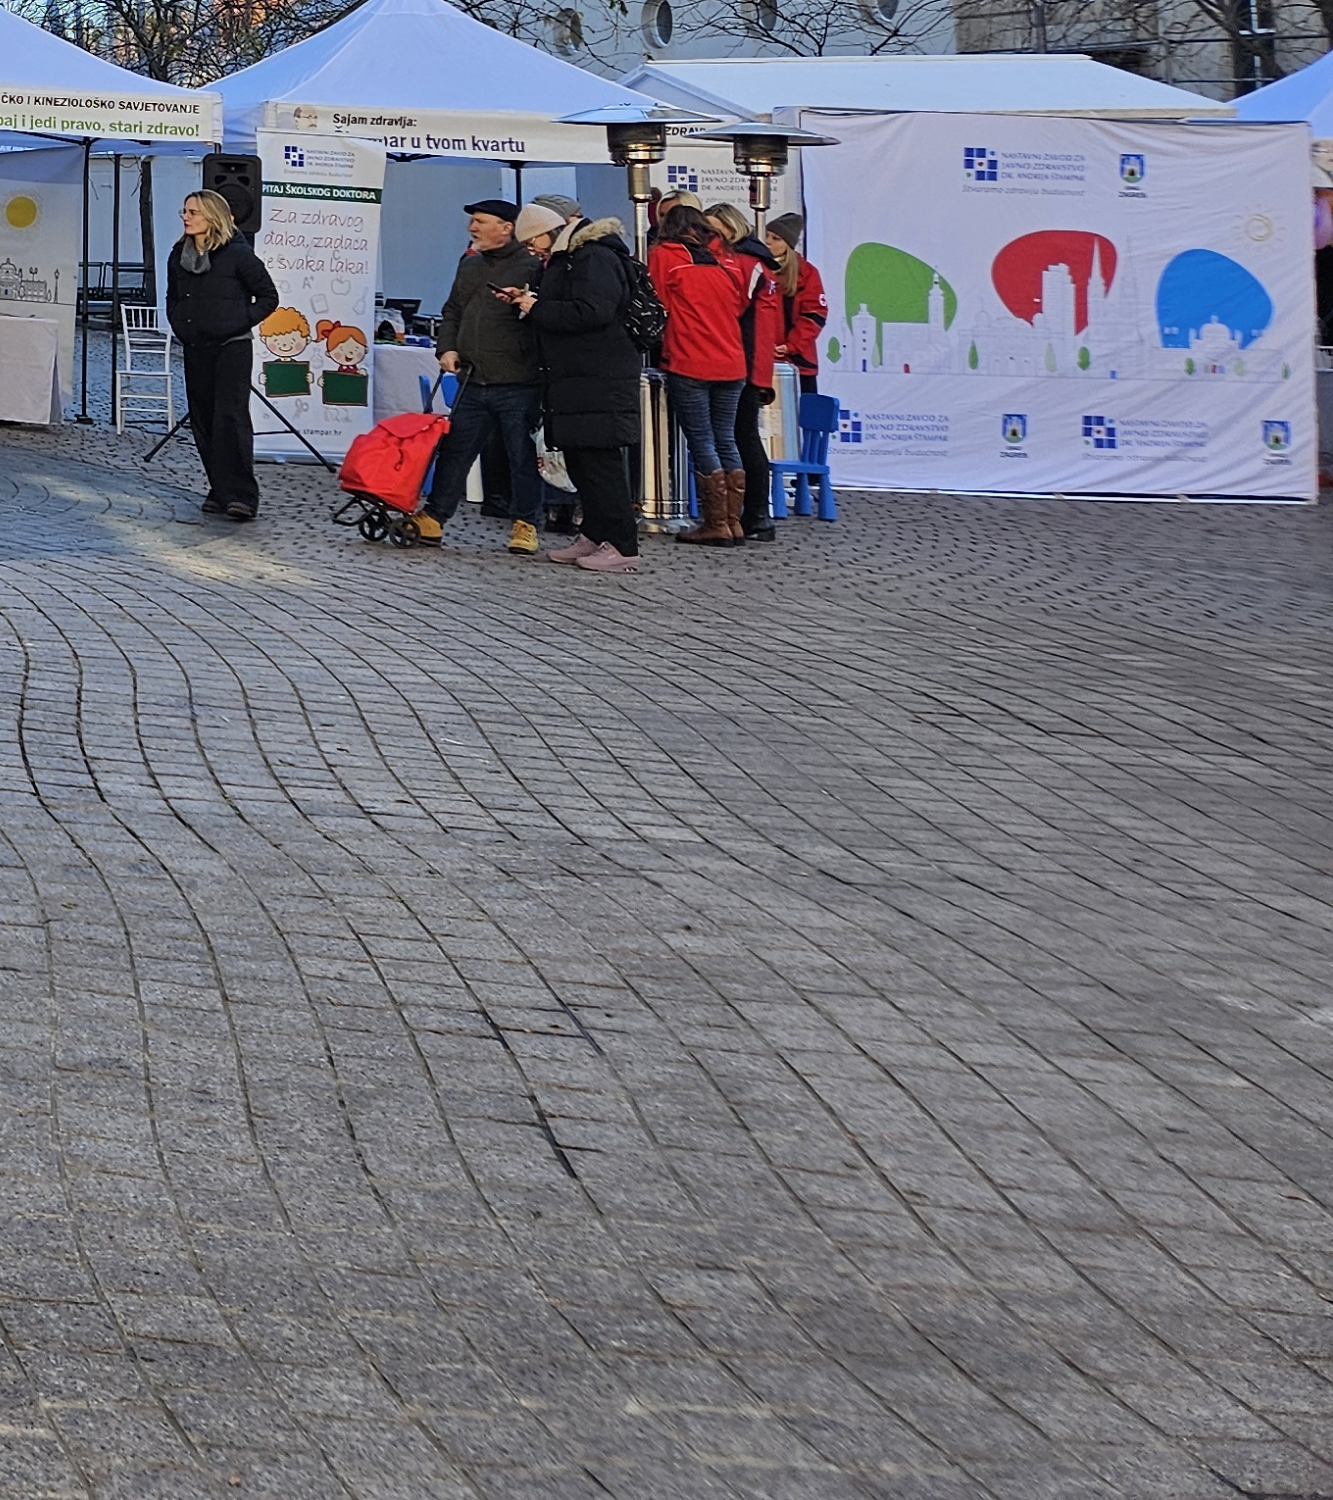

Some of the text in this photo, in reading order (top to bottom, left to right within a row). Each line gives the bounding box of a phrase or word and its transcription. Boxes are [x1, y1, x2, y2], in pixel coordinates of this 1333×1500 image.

[27, 96, 30, 105] I
[34, 95, 115, 110] KINEZIOLOŠKO
[118, 100, 200, 114] SAVJETOVANJE
[21, 114, 25, 126] i
[30, 114, 56, 130] jedi
[61, 118, 105, 133] pravo,
[109, 118, 143, 133] stari
[147, 121, 200, 137] zdravo!
[333, 114, 417, 128] Sajam zdravlja:
[411, 136, 420, 149] u
[426, 134, 466, 150] tvom
[471, 135, 525, 153] kvartu
[262, 184, 377, 200] PITAJ ŠKOLSKOG DOKTORA
[269, 208, 363, 233] Za zdravog
[278, 256, 324, 272] svaka
[330, 258, 368, 274] laka!
